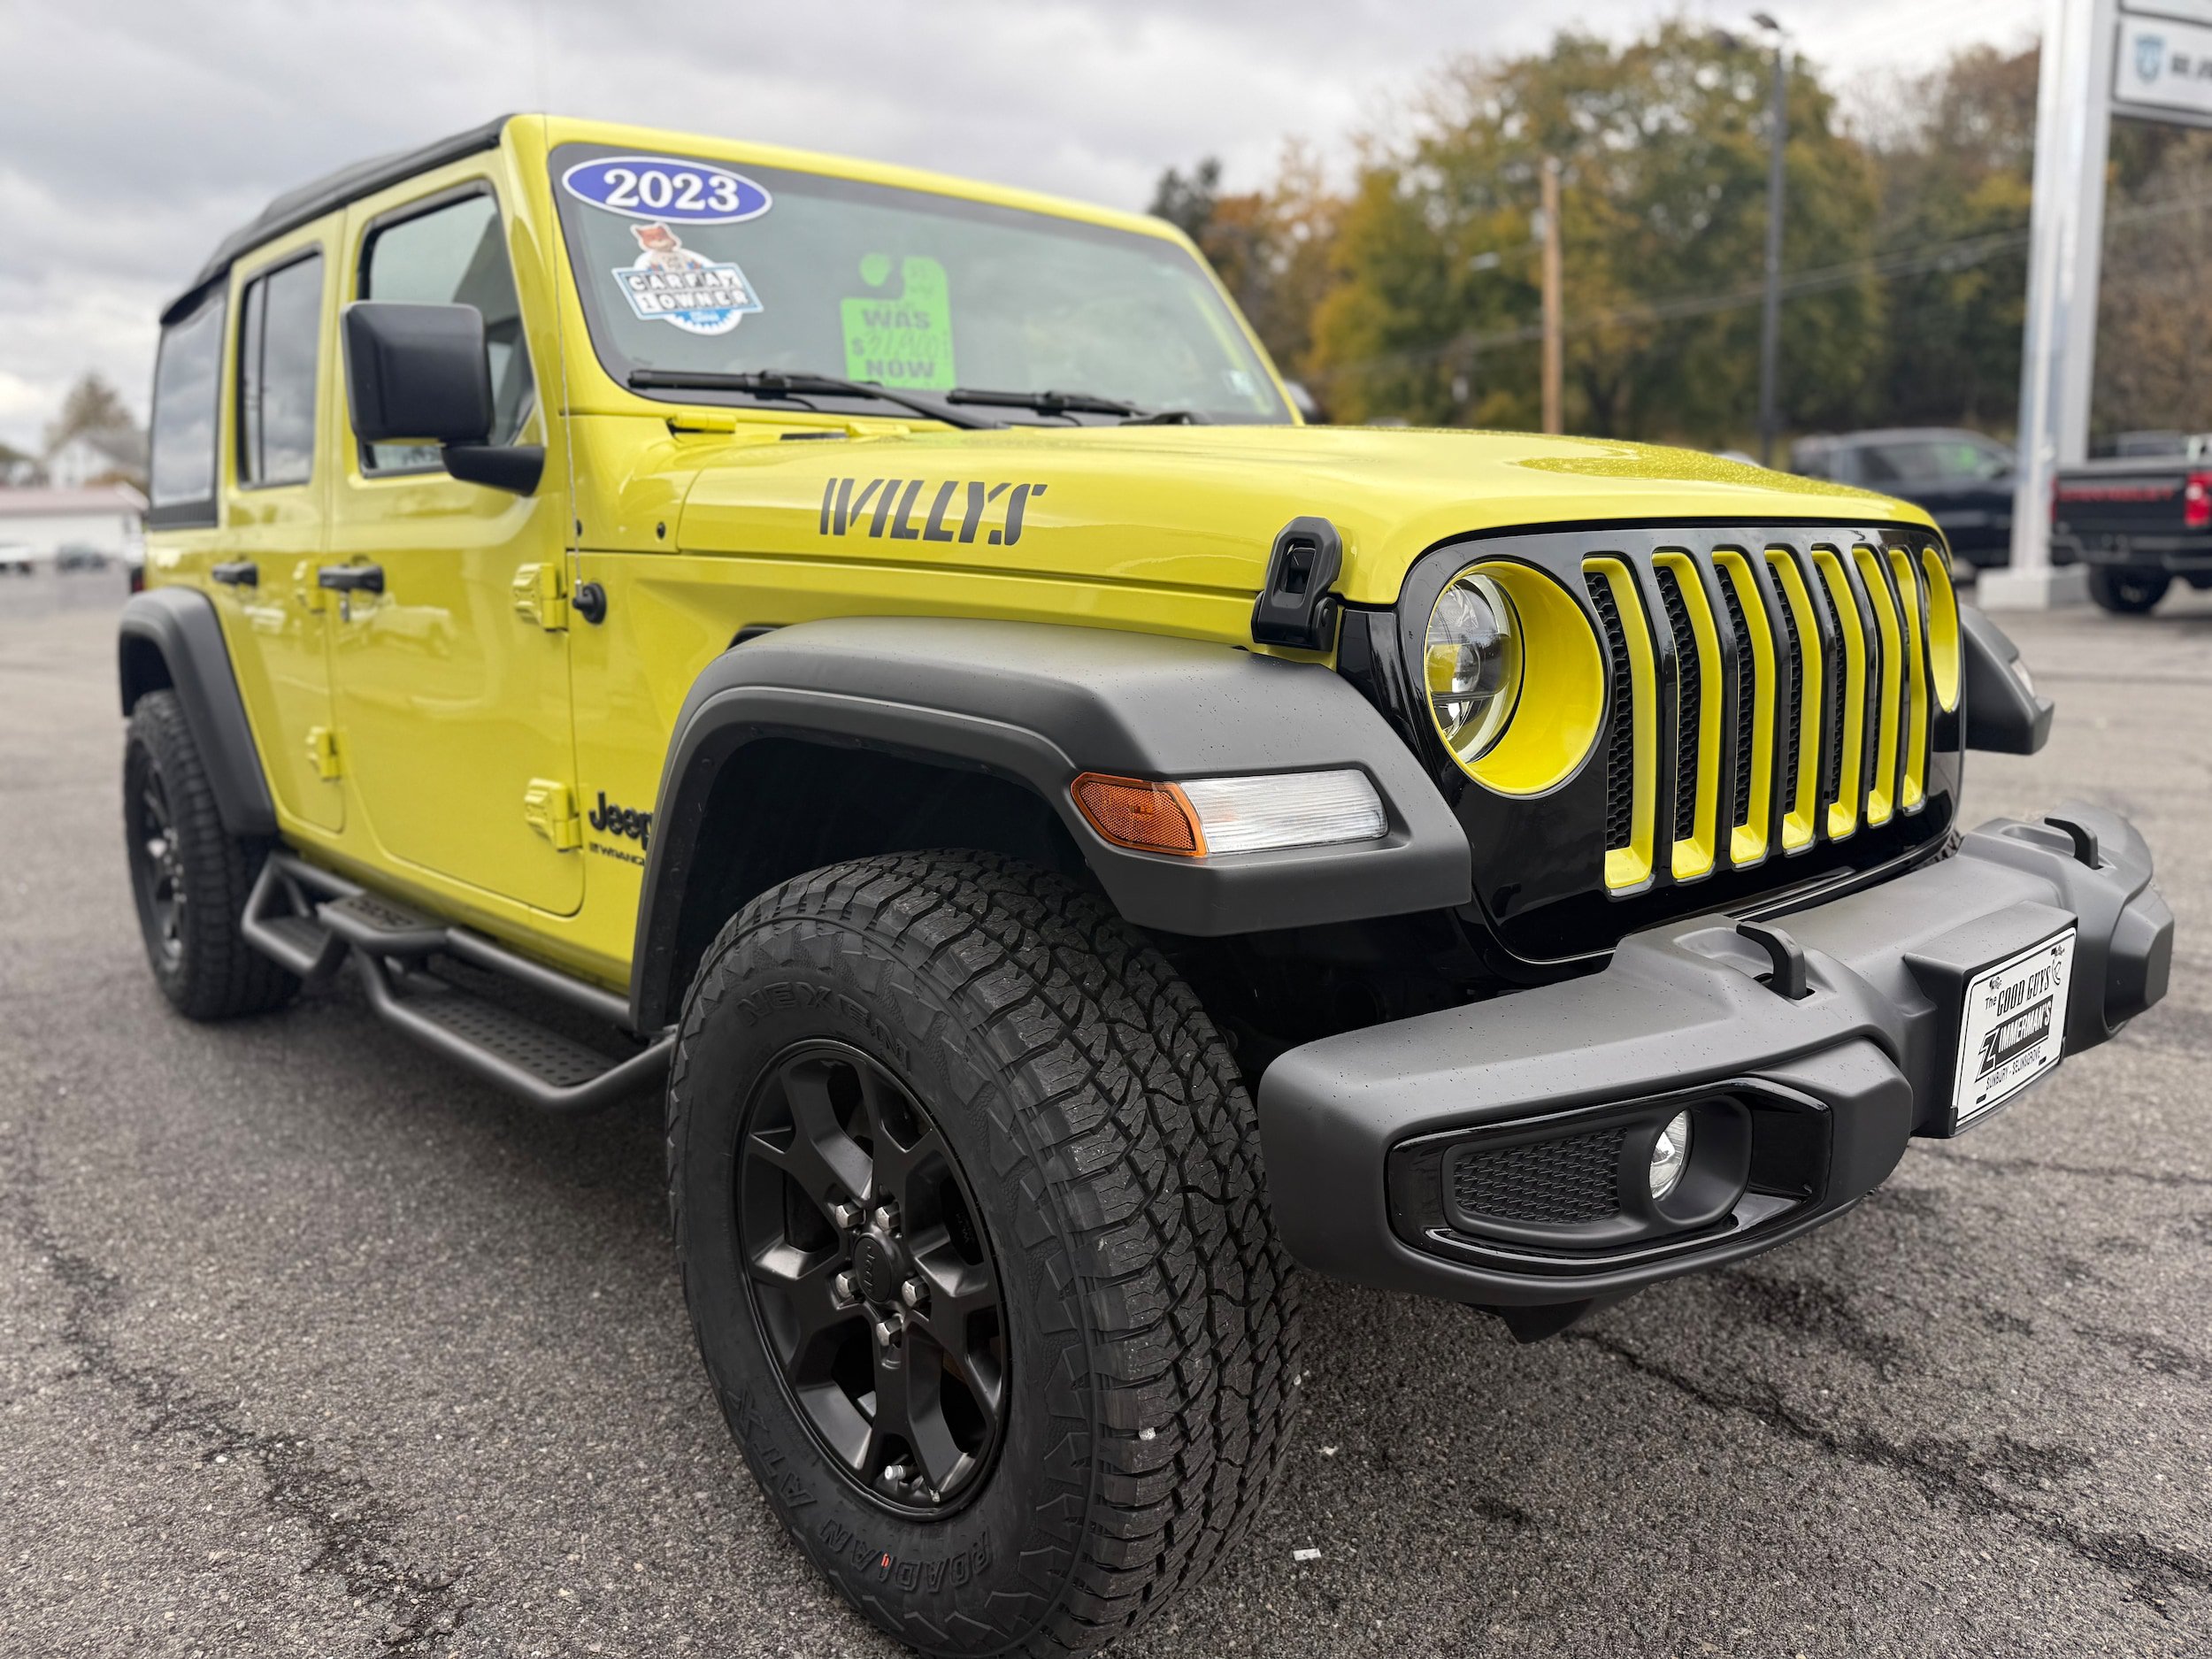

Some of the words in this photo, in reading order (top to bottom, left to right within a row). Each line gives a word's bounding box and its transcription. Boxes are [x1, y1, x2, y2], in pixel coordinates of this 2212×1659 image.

[603, 168, 740, 212] 2023
[628, 270, 741, 293] CARFAX
[659, 289, 749, 311] OWNER
[862, 308, 933, 330] WAS
[865, 357, 936, 380] NOW
[819, 478, 1048, 546] WILLYS
[588, 790, 652, 850] Jeep
[602, 846, 645, 866] WRANG
[1985, 995, 1997, 1010] The
[1997, 979, 2025, 1017] GOOD
[2026, 964, 2052, 1002] GUYS
[736, 980, 912, 1074] NEXEN
[1975, 998, 2053, 1083] ZIMMERMAN'S
[1985, 1065, 2008, 1090] SUNBURY
[2013, 1046, 2041, 1075] SELINSGROVE
